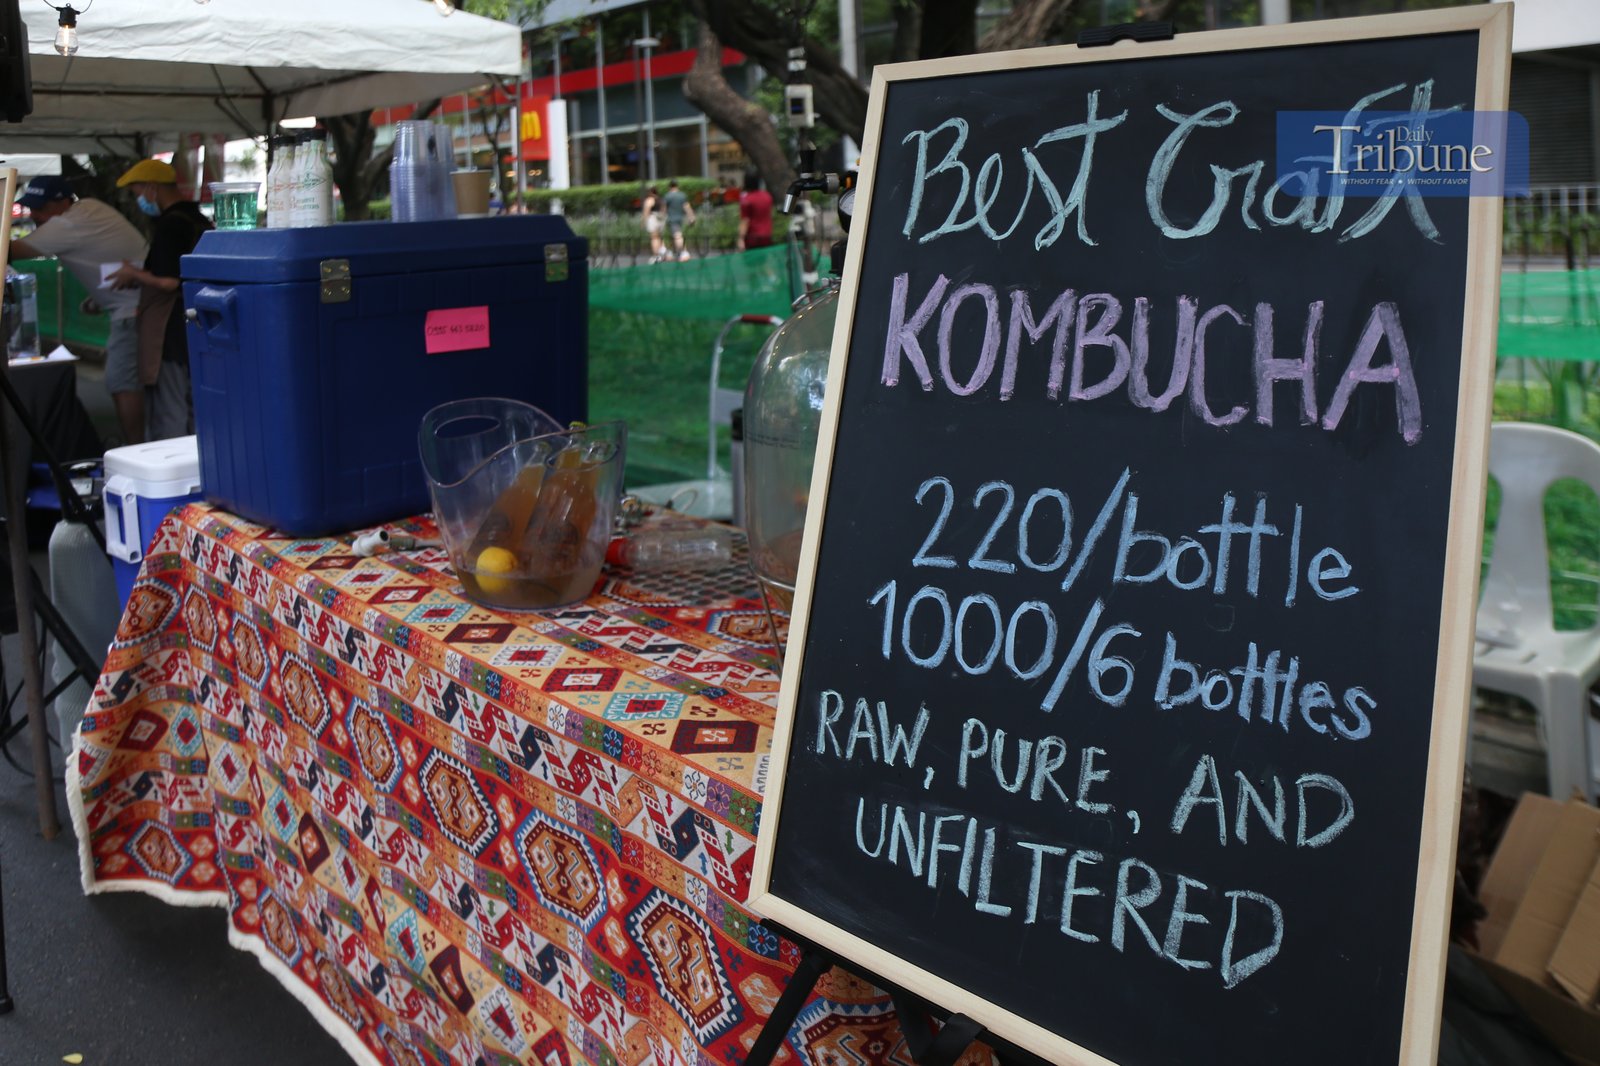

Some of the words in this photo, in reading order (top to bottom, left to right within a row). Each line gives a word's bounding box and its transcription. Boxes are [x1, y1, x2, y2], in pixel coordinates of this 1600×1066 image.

[902, 88, 1129, 251] Best
[1146, 79, 1467, 246] Craft
[881, 272, 1423, 447] KOMBUCHA
[912, 465, 1364, 608] 220/bottle
[867, 579, 1143, 713] 1000/6
[1154, 630, 1378, 741] bottles
[815, 689, 936, 790] RAW,
[1172, 754, 1356, 848] AND
[855, 797, 1285, 990] UNFILTERED
